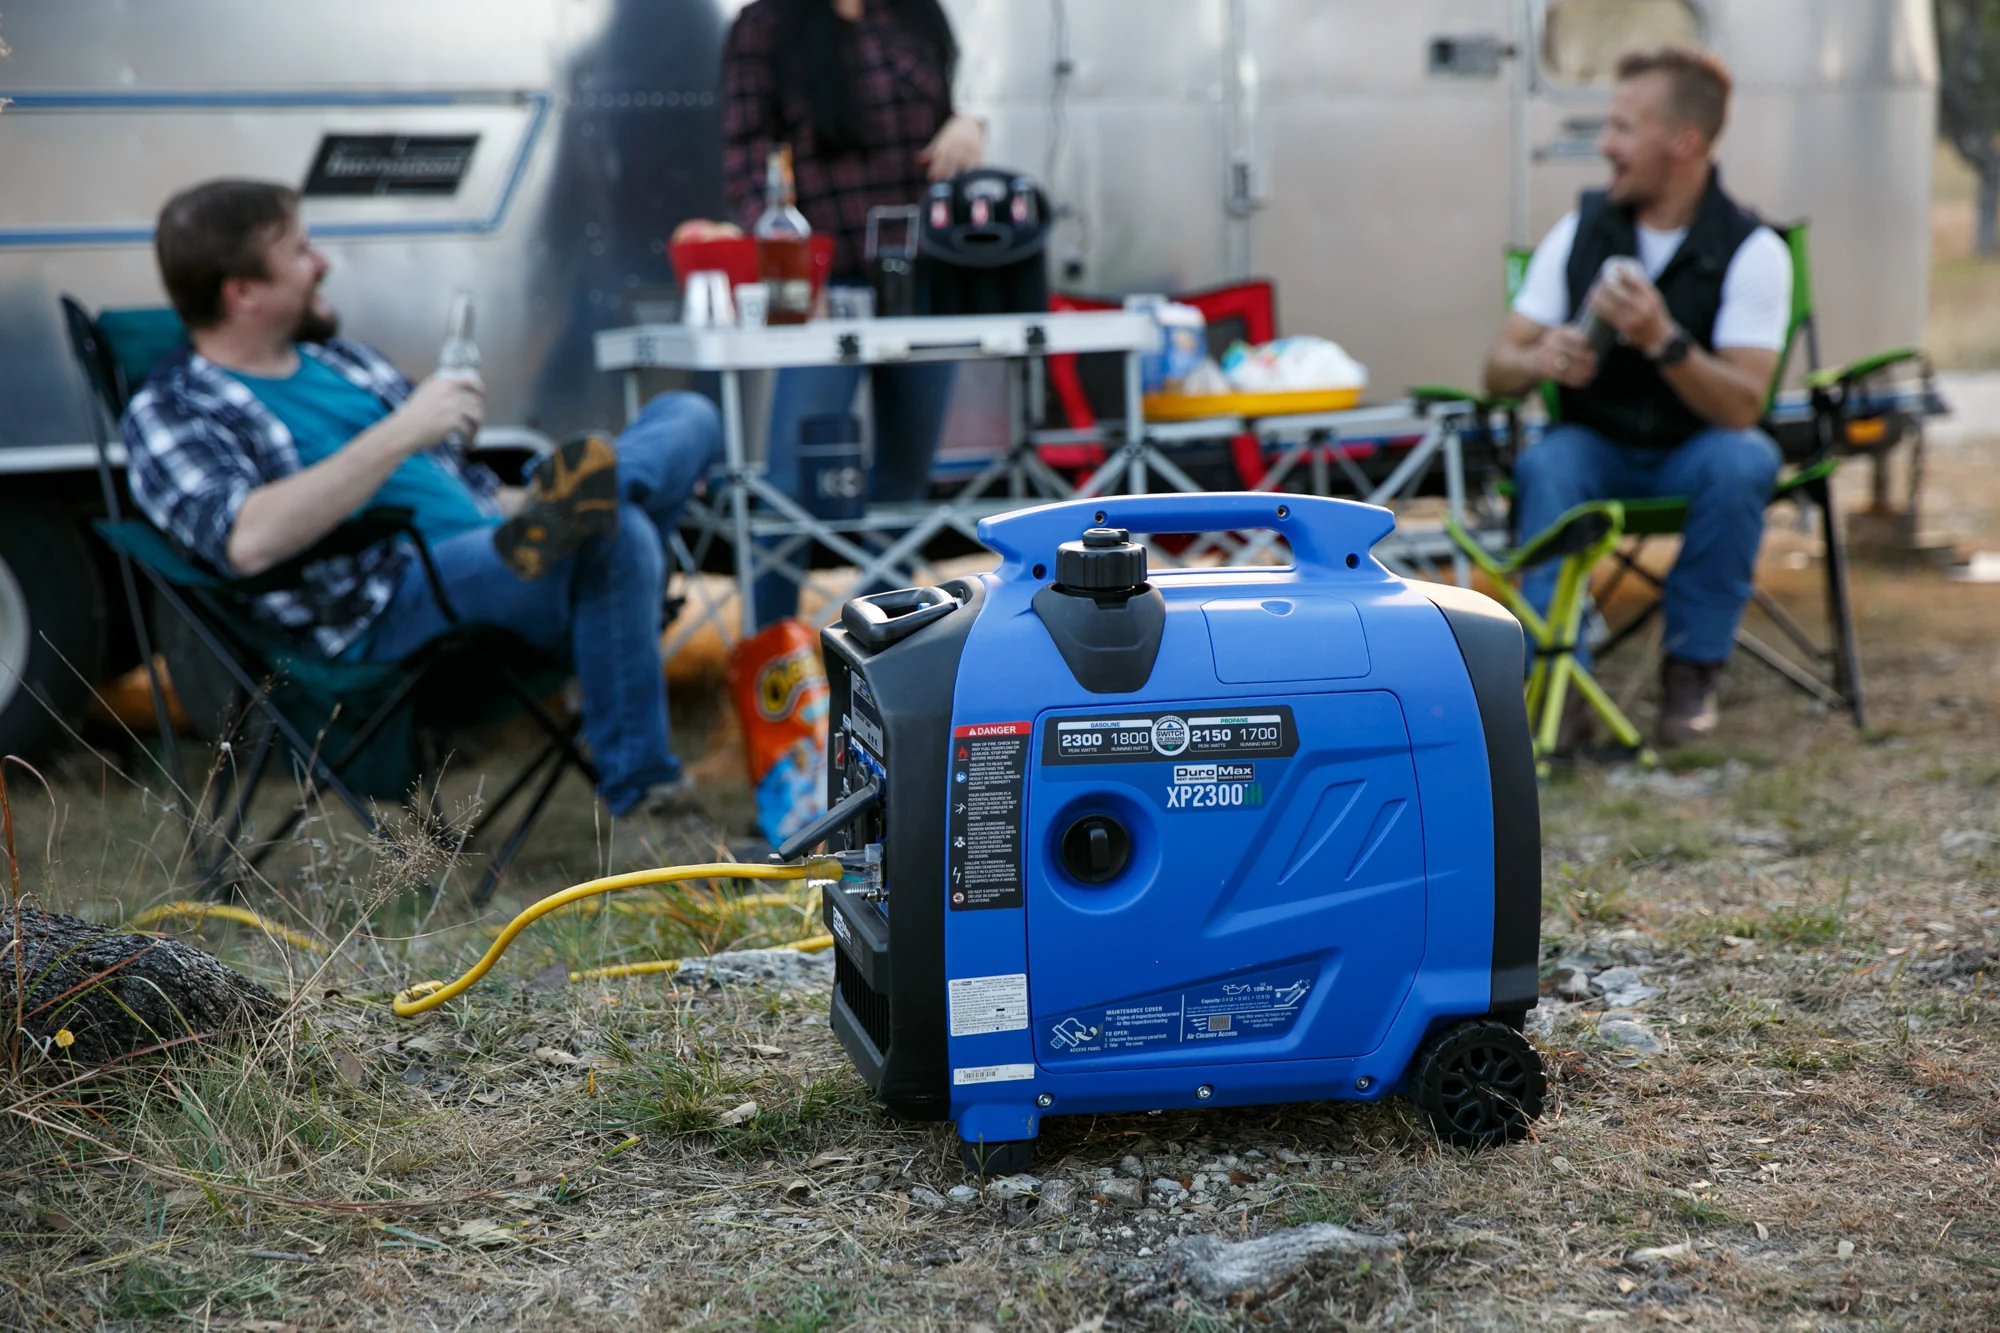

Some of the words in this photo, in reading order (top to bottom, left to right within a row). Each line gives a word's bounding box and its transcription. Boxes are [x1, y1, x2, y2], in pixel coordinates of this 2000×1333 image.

[978, 726, 1016, 734] DANGER
[1192, 729, 1231, 742] 2150
[1240, 728, 1277, 740] 1700
[1062, 734, 1102, 746] 2300
[1111, 732, 1149, 745] 1800
